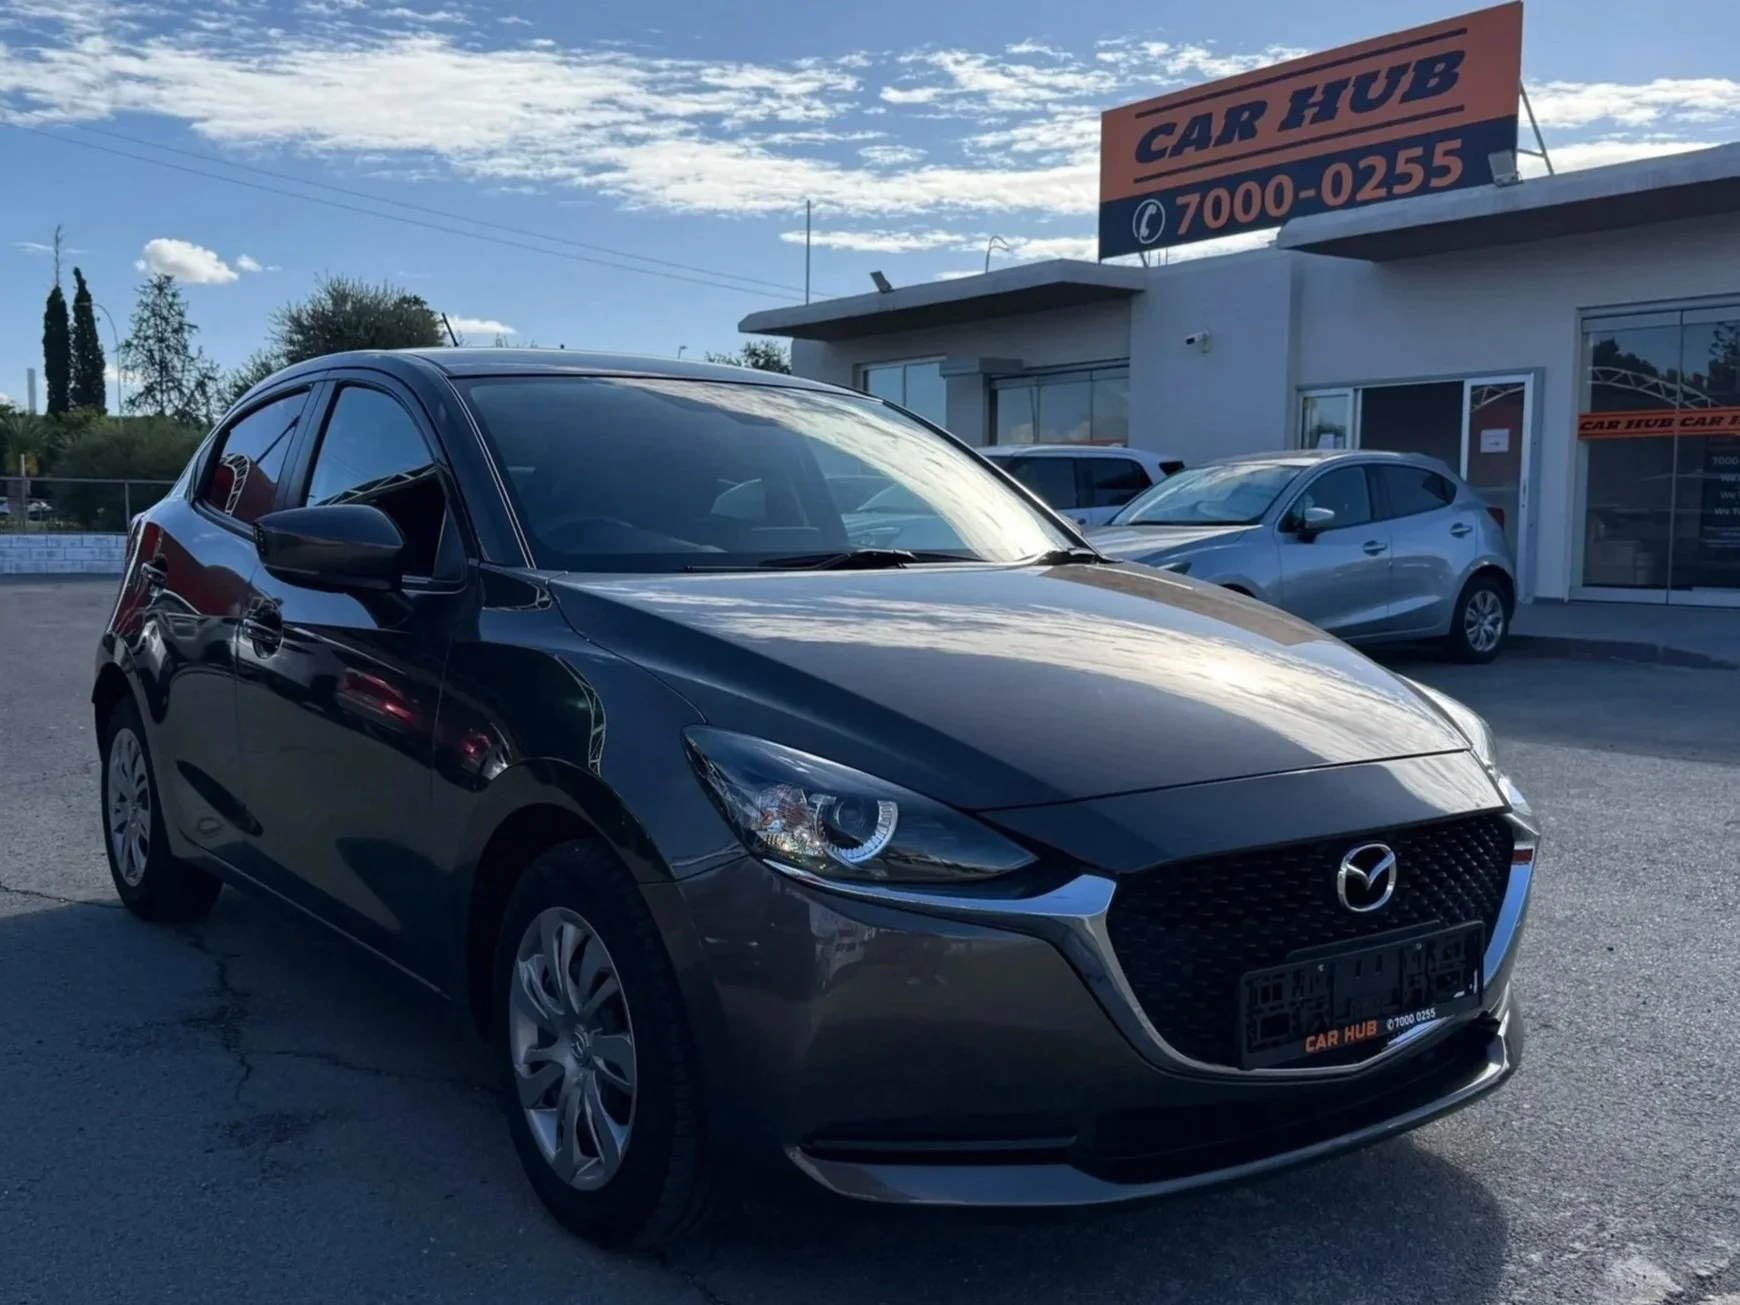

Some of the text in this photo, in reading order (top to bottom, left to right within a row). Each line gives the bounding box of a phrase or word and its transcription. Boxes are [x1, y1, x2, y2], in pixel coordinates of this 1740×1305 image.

[1134, 50, 1466, 164] CAR HUB
[1175, 139, 1463, 236] 7000-0255
[1579, 419, 1621, 431] CAR
[1624, 417, 1674, 430] HUB
[1680, 415, 1724, 427] CAR
[1395, 1007, 1436, 1028] 7000 0255
[1305, 1020, 1377, 1052] CAR HUB
